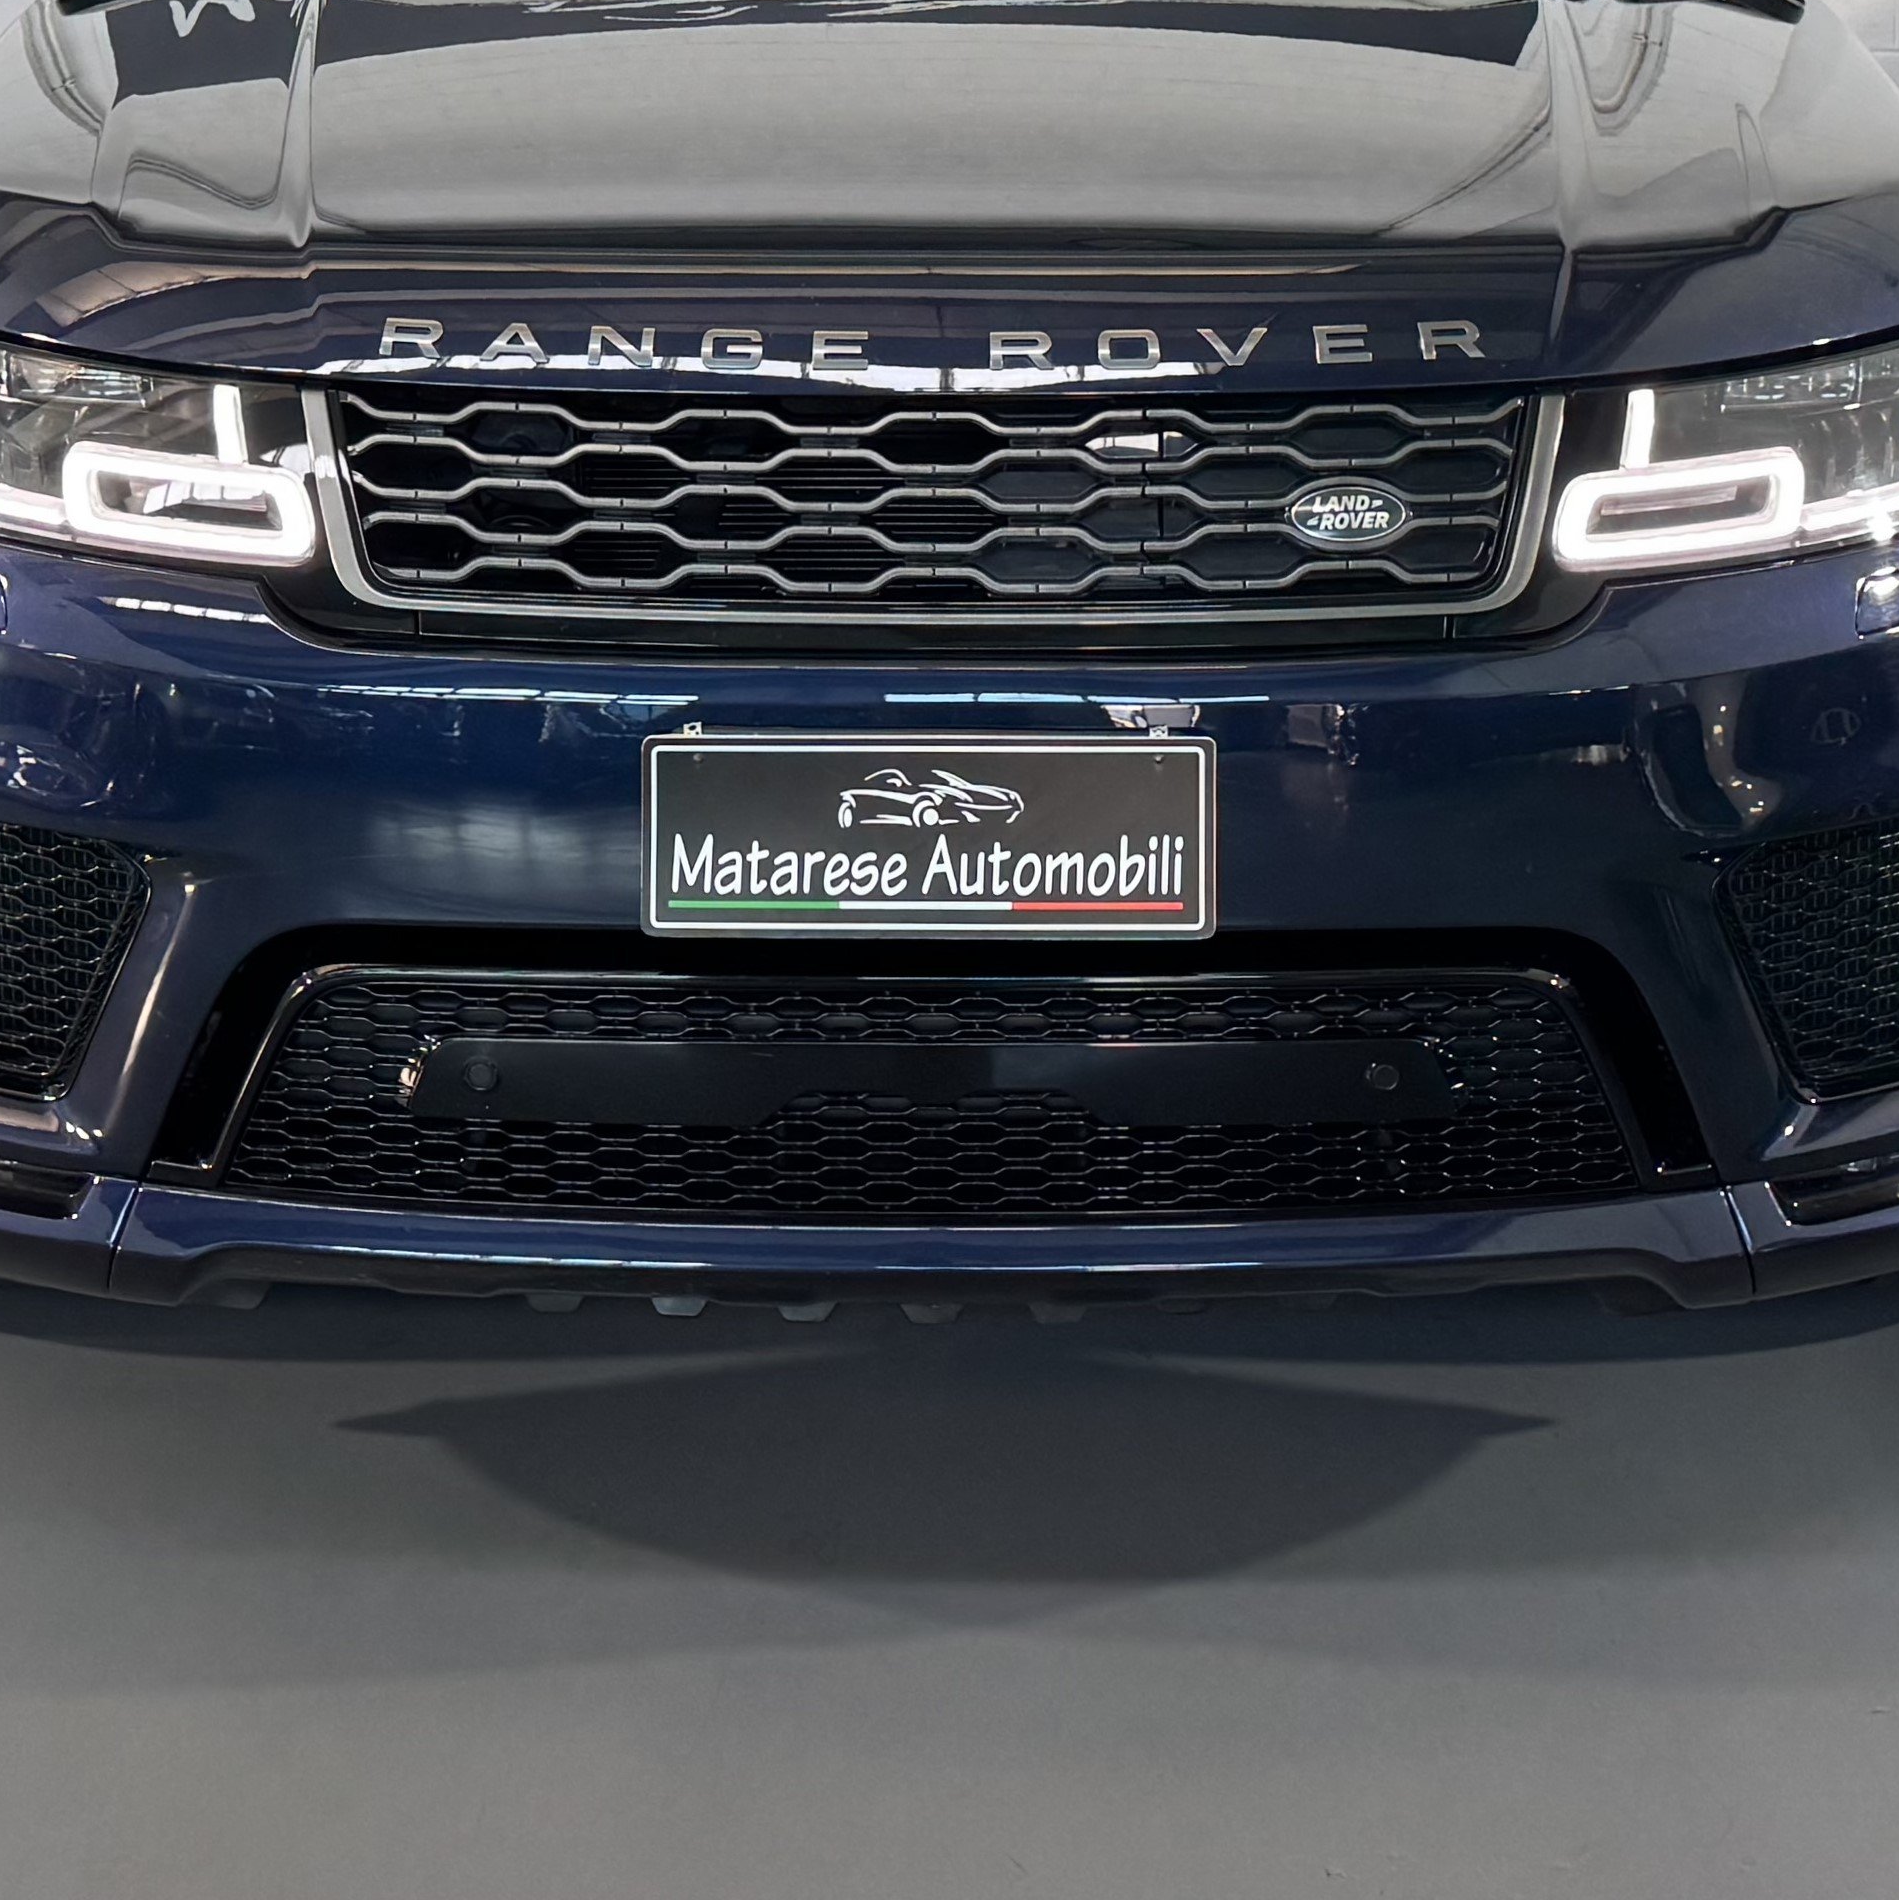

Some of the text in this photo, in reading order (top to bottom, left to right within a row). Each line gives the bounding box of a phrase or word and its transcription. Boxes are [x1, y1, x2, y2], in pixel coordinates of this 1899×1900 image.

[379, 317, 1486, 371] RANGE ROVER
[1311, 494, 1372, 514] LAND
[1318, 510, 1391, 531] ROVER
[670, 832, 1185, 898] Matarese Automobili
